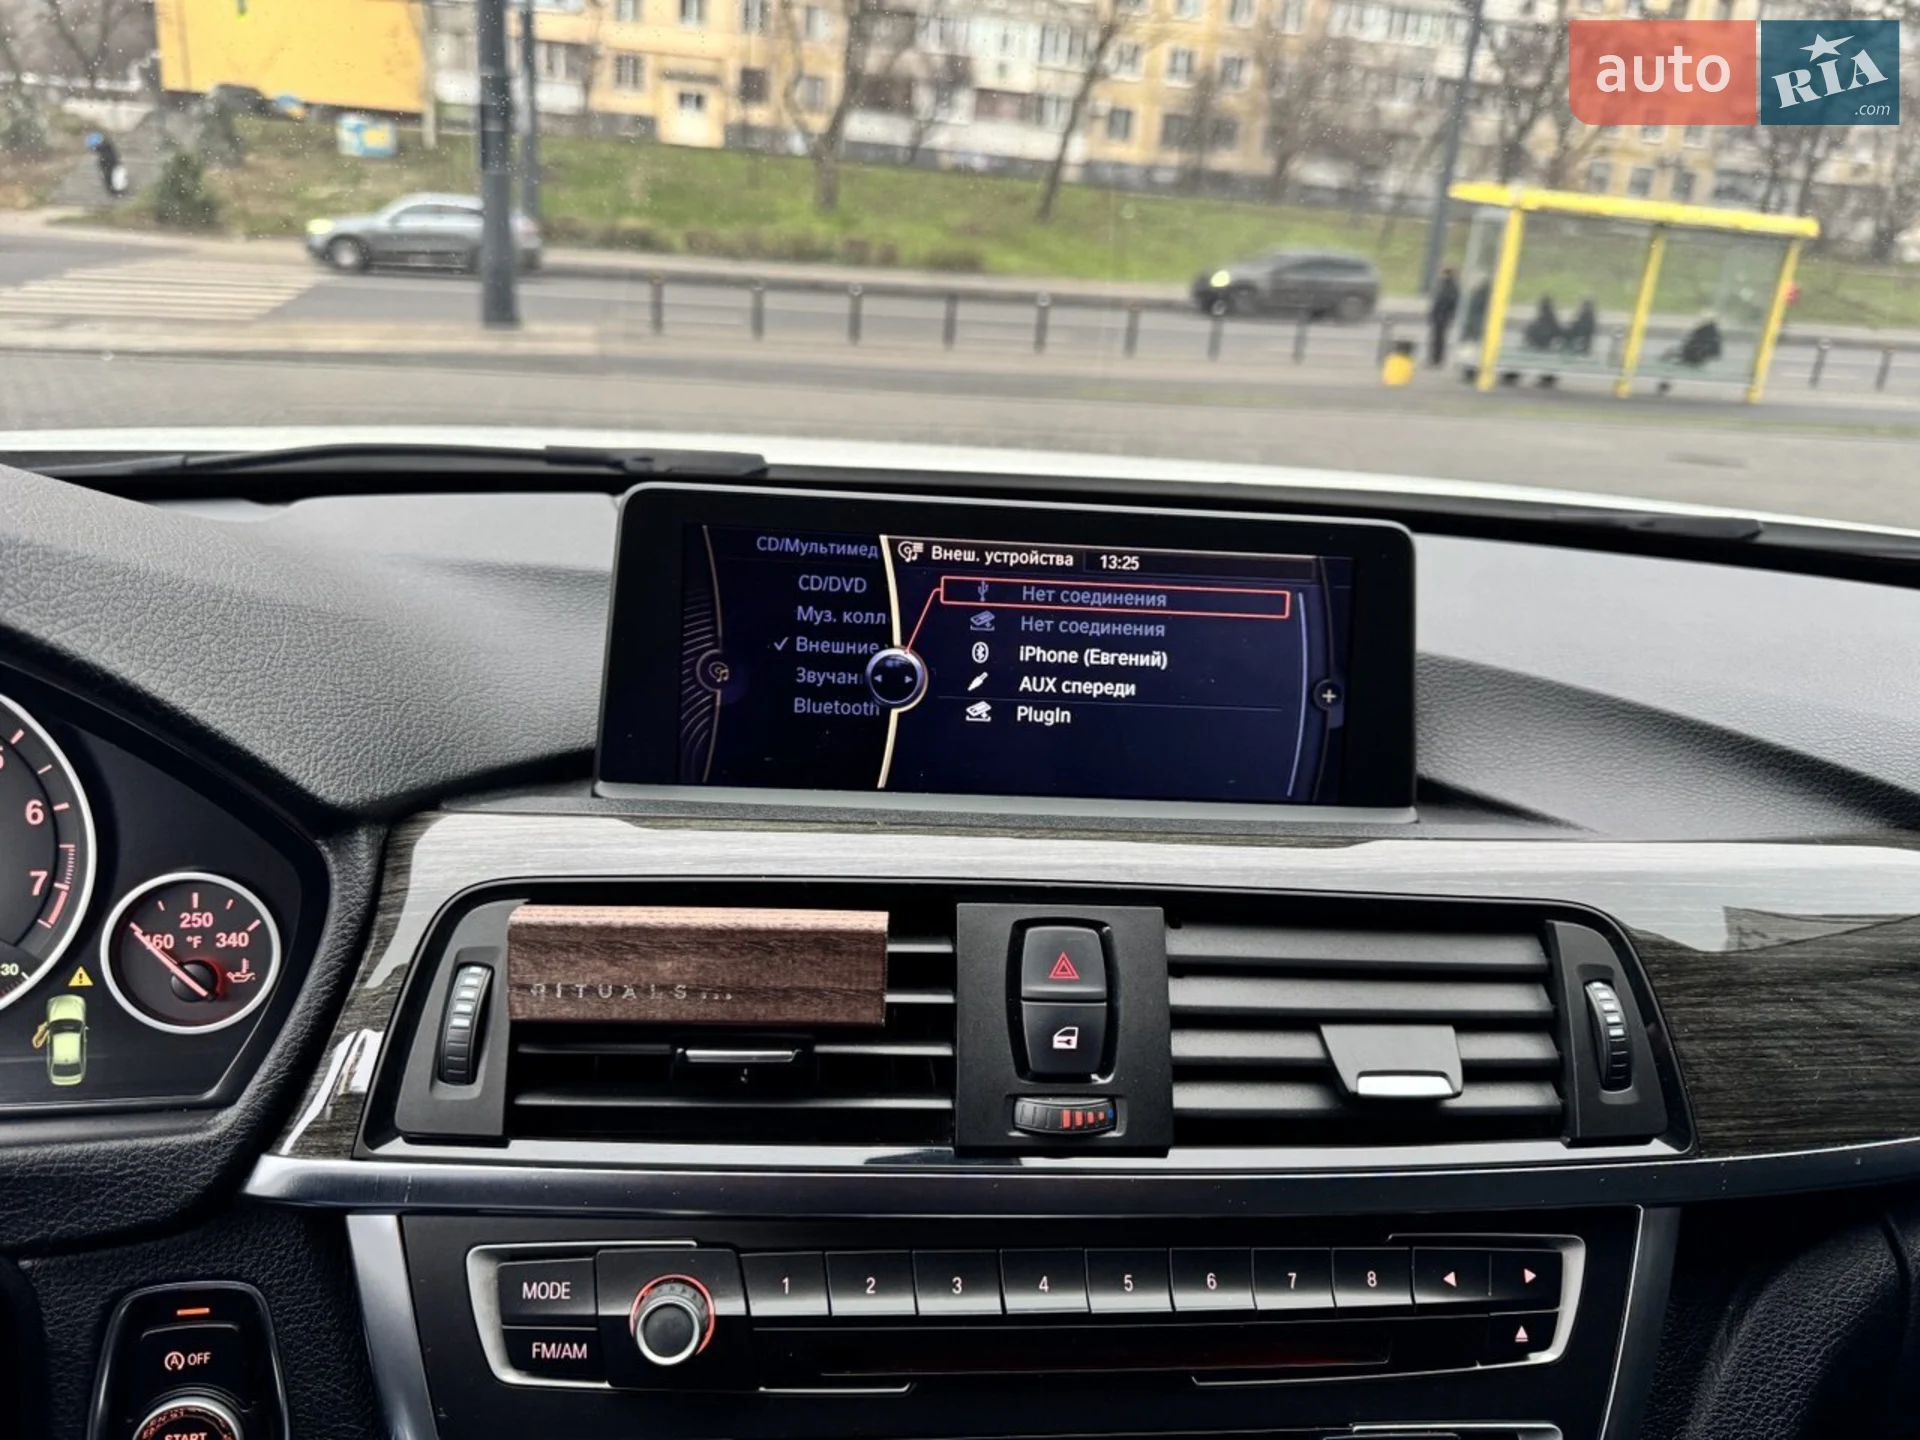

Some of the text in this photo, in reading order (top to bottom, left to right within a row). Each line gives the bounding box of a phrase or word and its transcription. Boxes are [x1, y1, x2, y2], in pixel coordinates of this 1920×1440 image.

[931, 545, 1074, 567] Внеш. устройства
[1099, 554, 1140, 571] 13:25
[798, 574, 867, 594] CD/DVD
[1021, 585, 1167, 608] Нет соединения
[797, 605, 887, 626] Муз. колл
[1020, 615, 1166, 638] Нет соединения
[795, 635, 880, 655] Внешние
[1019, 645, 1168, 671] iPhone (Евгений)
[1018, 676, 1137, 698] AUX спереди
[793, 697, 881, 717] Bluetooth
[1016, 705, 1072, 727] PlugIn
[25, 800, 45, 826] 6
[29, 870, 49, 897] 7
[178, 912, 214, 929] 250
[215, 932, 250, 948] 340
[782, 1277, 791, 1295] 1
[865, 1276, 876, 1295] 2
[952, 1276, 963, 1294] 3
[1038, 1276, 1050, 1293] 4
[1123, 1274, 1134, 1292] 5
[1206, 1273, 1217, 1290] 6
[1288, 1272, 1297, 1290] 7
[1366, 1271, 1378, 1288] 8
[522, 1281, 572, 1301] MODE
[187, 1351, 212, 1366] OFF
[531, 1341, 588, 1360] FM/AM
